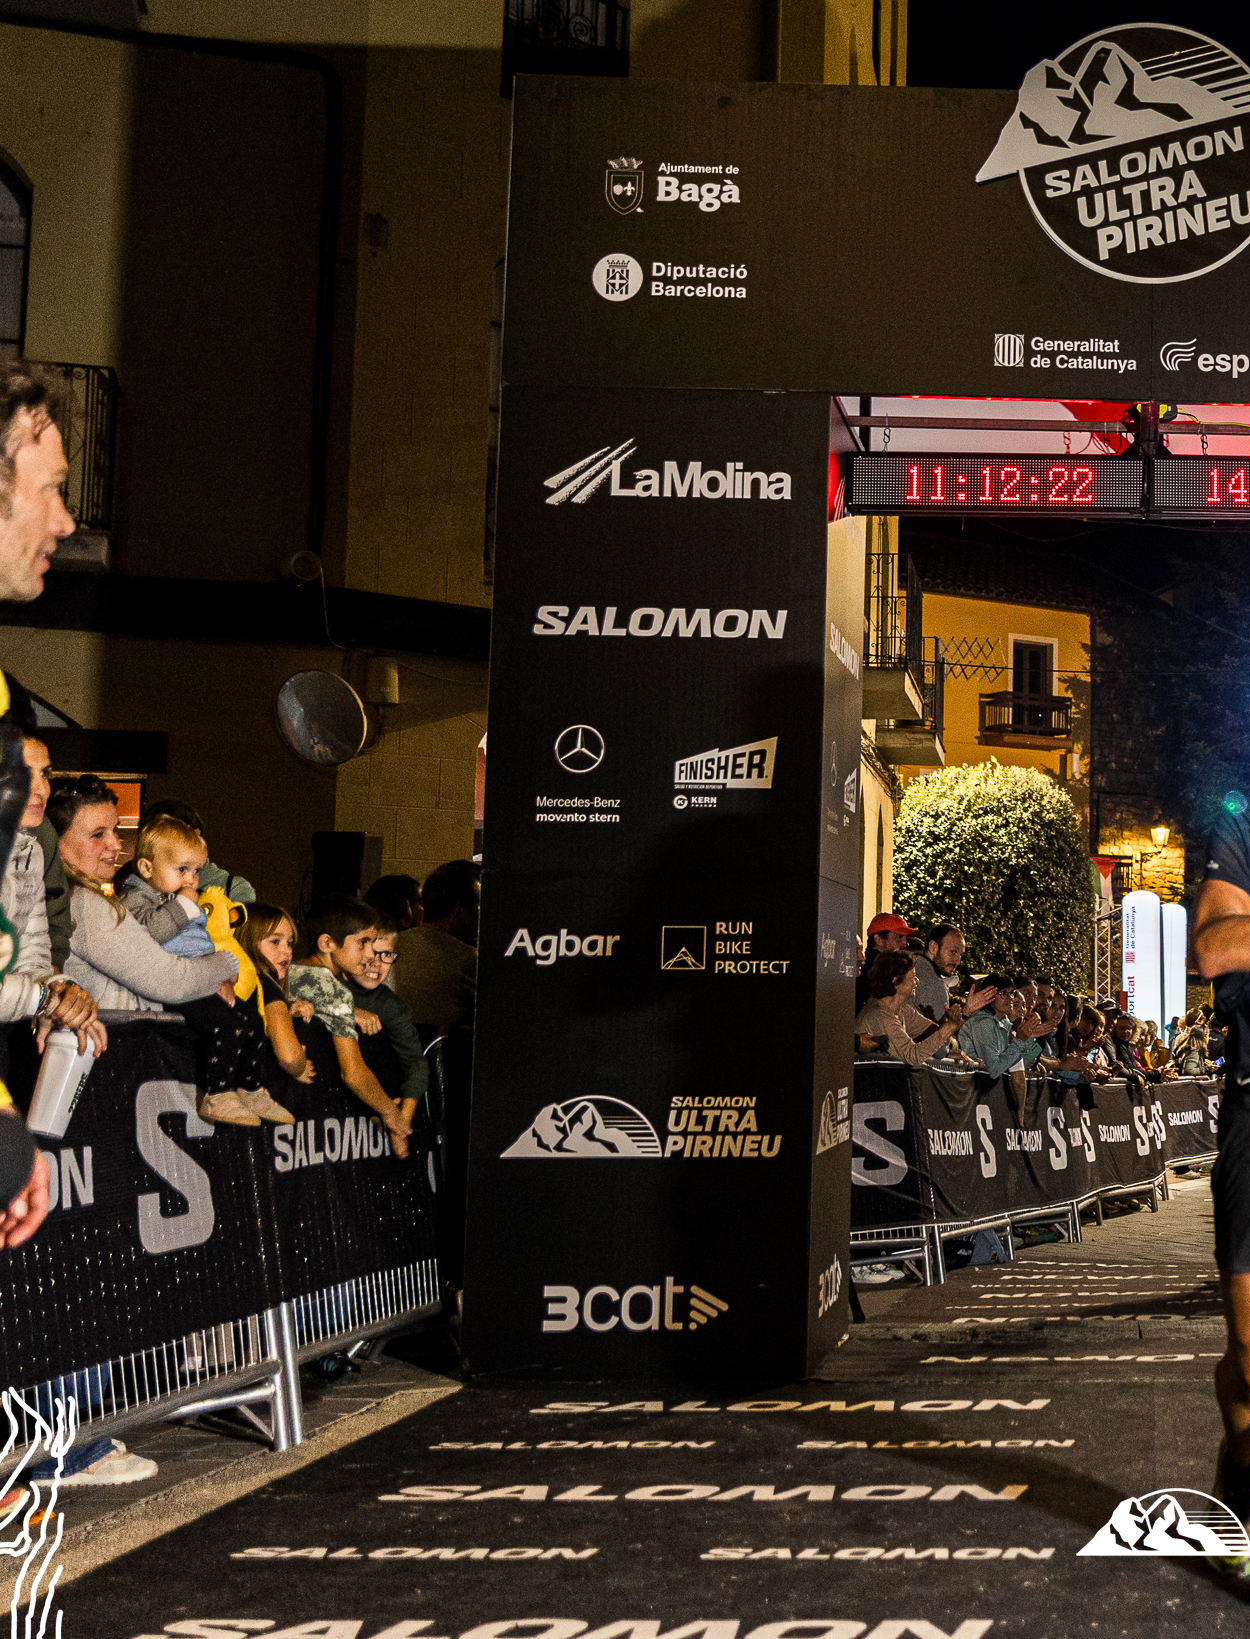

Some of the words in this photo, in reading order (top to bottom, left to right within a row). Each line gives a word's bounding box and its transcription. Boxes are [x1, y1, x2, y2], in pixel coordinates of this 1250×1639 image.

[658, 162, 723, 176] Ajuntament
[725, 164, 740, 174] de
[1044, 126, 1245, 198] SALOMON
[656, 176, 741, 212] Bagà
[1077, 170, 1207, 228] ULTRA
[652, 261, 748, 281] Diputació
[651, 281, 747, 299] Barcelona
[1030, 336, 1120, 353] Generalitat
[1030, 354, 1051, 369] de
[1055, 355, 1138, 374] Catalunya
[906, 465, 1094, 502] 11:12:22
[532, 605, 788, 640] SALOMON
[536, 795, 621, 808] Mercedes-Benz
[691, 796, 717, 804] KERN
[588, 812, 620, 823] stern
[715, 921, 753, 935] RUN
[504, 928, 620, 966] Agbar
[715, 941, 751, 954] BIKE
[714, 960, 790, 974] PROTECT
[670, 1095, 757, 1108] SALOMON
[667, 1109, 758, 1133] ULTRA
[663, 1134, 782, 1158] PIRINEU
[927, 1128, 974, 1156] SALOMON
[542, 1276, 685, 1332] 3cat
[529, 1399, 1052, 1415] SALOMON
[428, 1440, 717, 1450] SALOMON
[796, 1439, 1076, 1449] SALOMON
[377, 1484, 1030, 1502] SALOMON
[230, 1546, 600, 1560] SALOMON
[700, 1547, 1057, 1561] SALOMON
[130, 1617, 994, 1639] SALOMON
